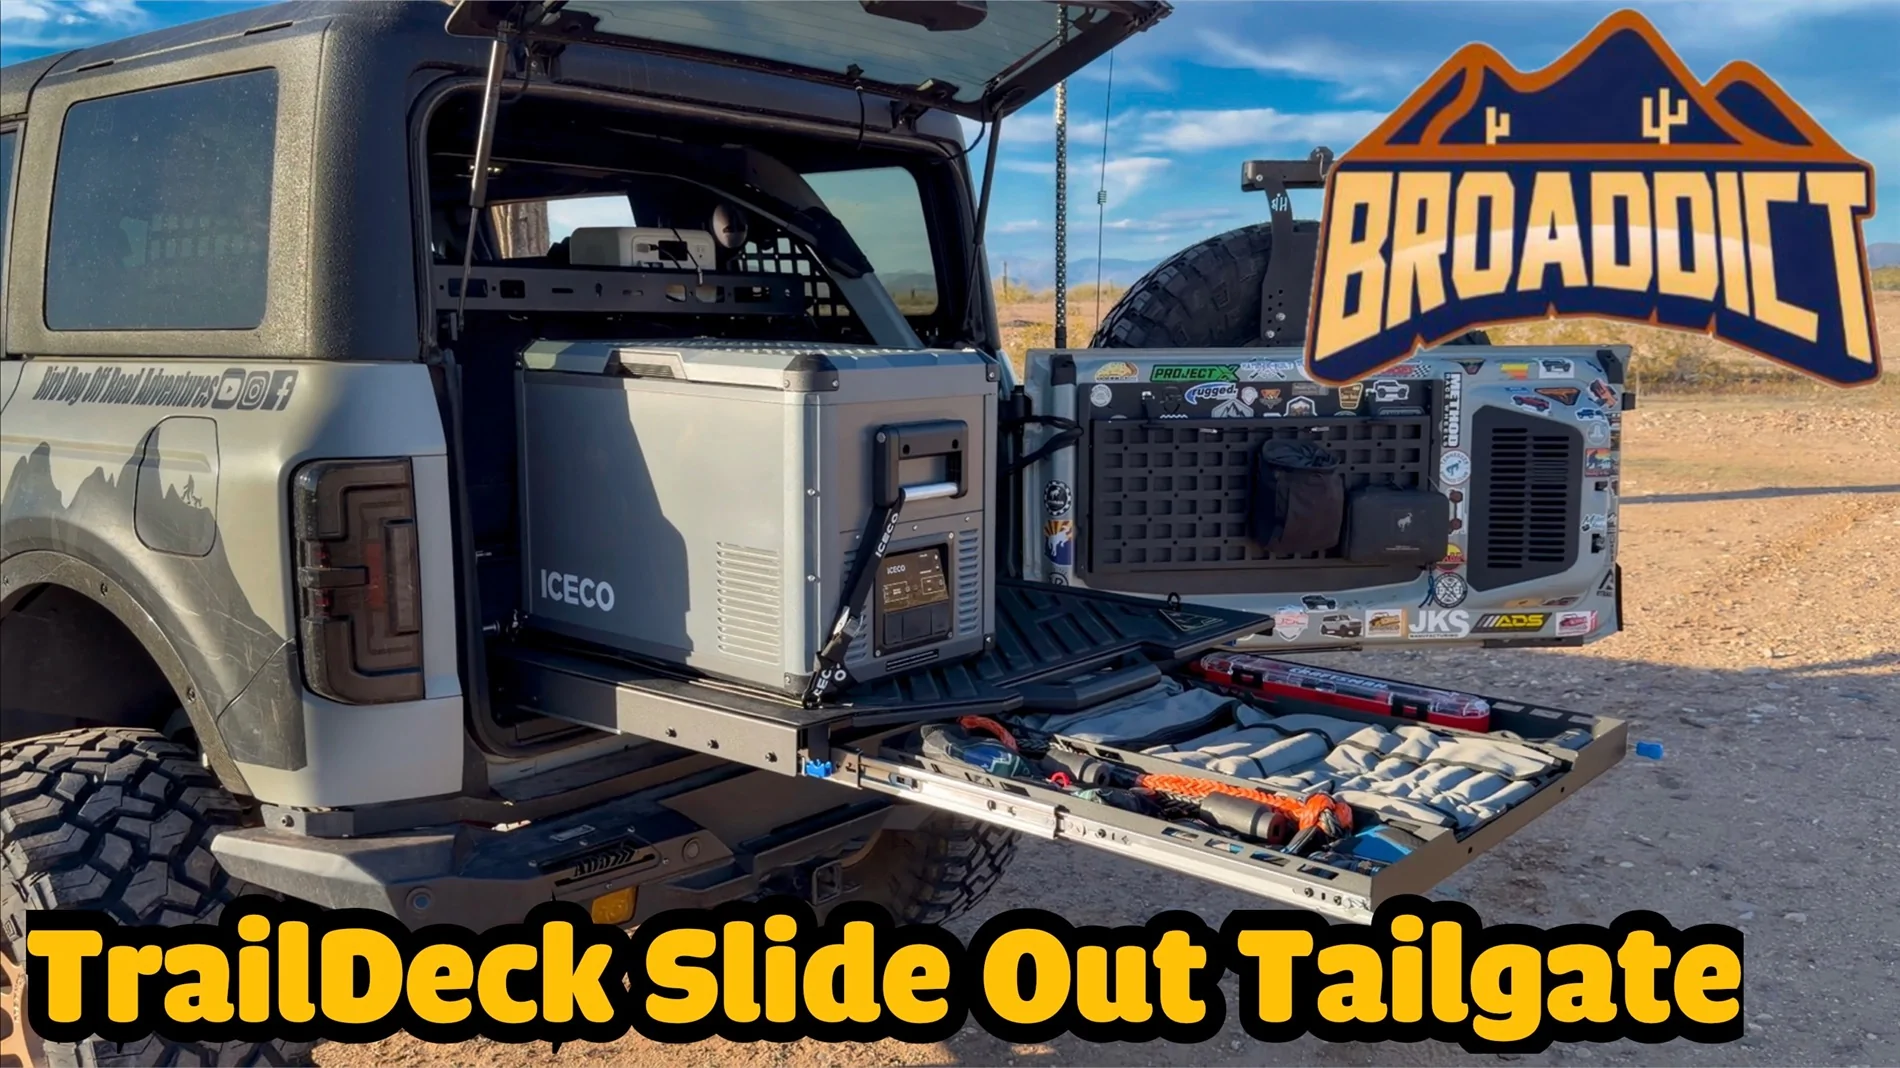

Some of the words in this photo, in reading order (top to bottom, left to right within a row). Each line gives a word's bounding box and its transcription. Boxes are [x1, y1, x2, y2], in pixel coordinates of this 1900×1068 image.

[32, 365, 70, 401] Bird
[56, 365, 92, 406] Dog
[81, 365, 113, 403] Off
[98, 366, 145, 405] Road
[131, 367, 220, 408] Adventures
[1154, 368, 1216, 379] PROJECT
[1448, 373, 1461, 447] METHOD
[875, 512, 899, 558] ICECO
[887, 564, 906, 575] ICECO
[540, 568, 615, 612] ICECO
[1408, 609, 1470, 637] JKS
[1495, 614, 1545, 628] ADS
